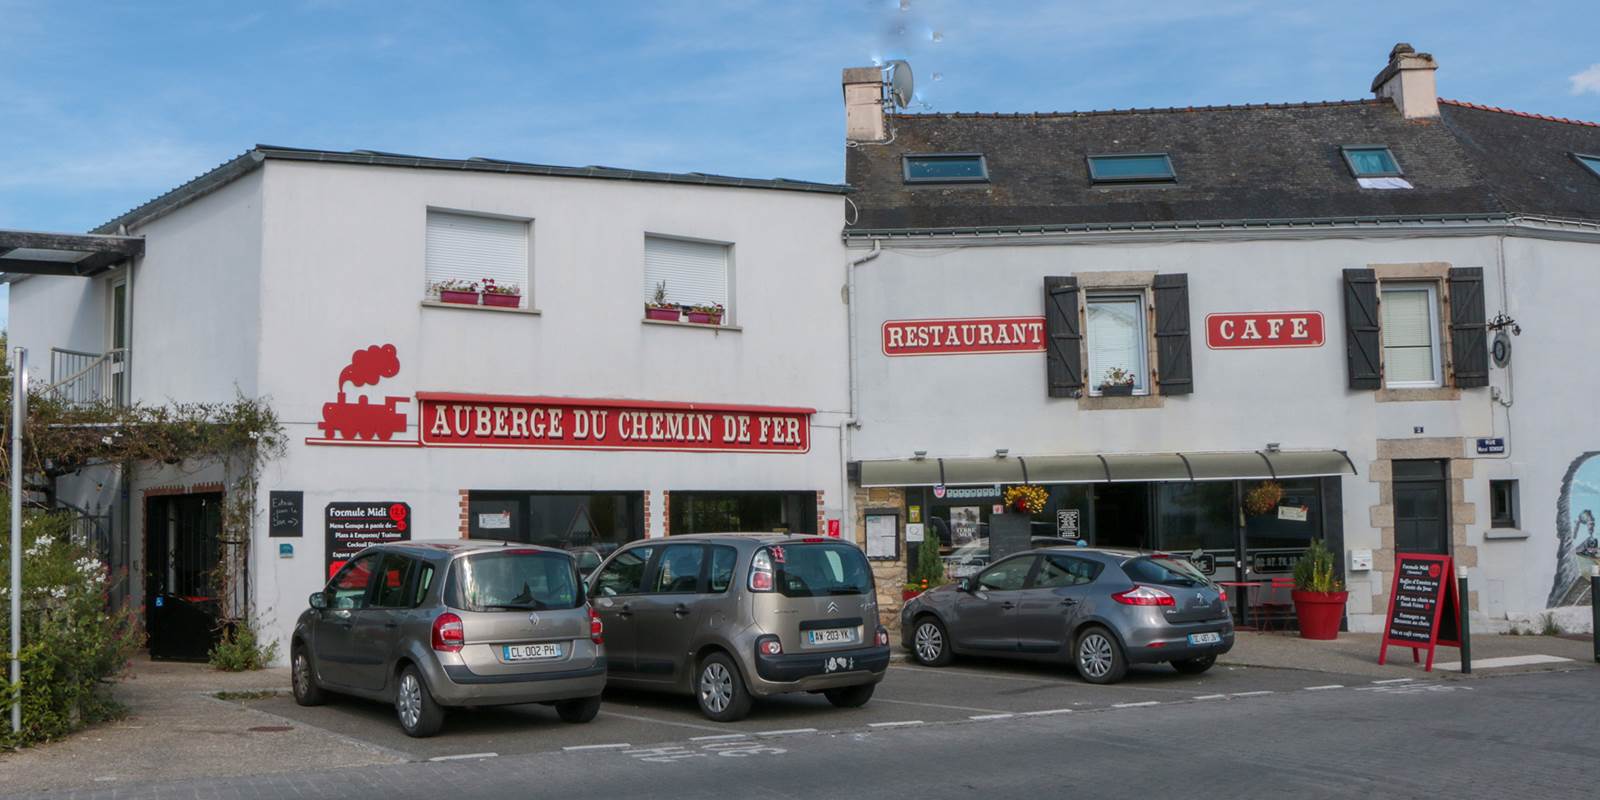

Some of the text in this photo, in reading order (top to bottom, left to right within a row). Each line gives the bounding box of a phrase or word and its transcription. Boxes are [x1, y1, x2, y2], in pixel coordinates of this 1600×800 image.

[888, 323, 1043, 348] RESTAURANT
[1220, 318, 1308, 340] CAFE
[431, 405, 801, 445] AUBERGE DU CHEMIN DE FER
[329, 507, 366, 517] Formule
[367, 507, 387, 517] Midi
